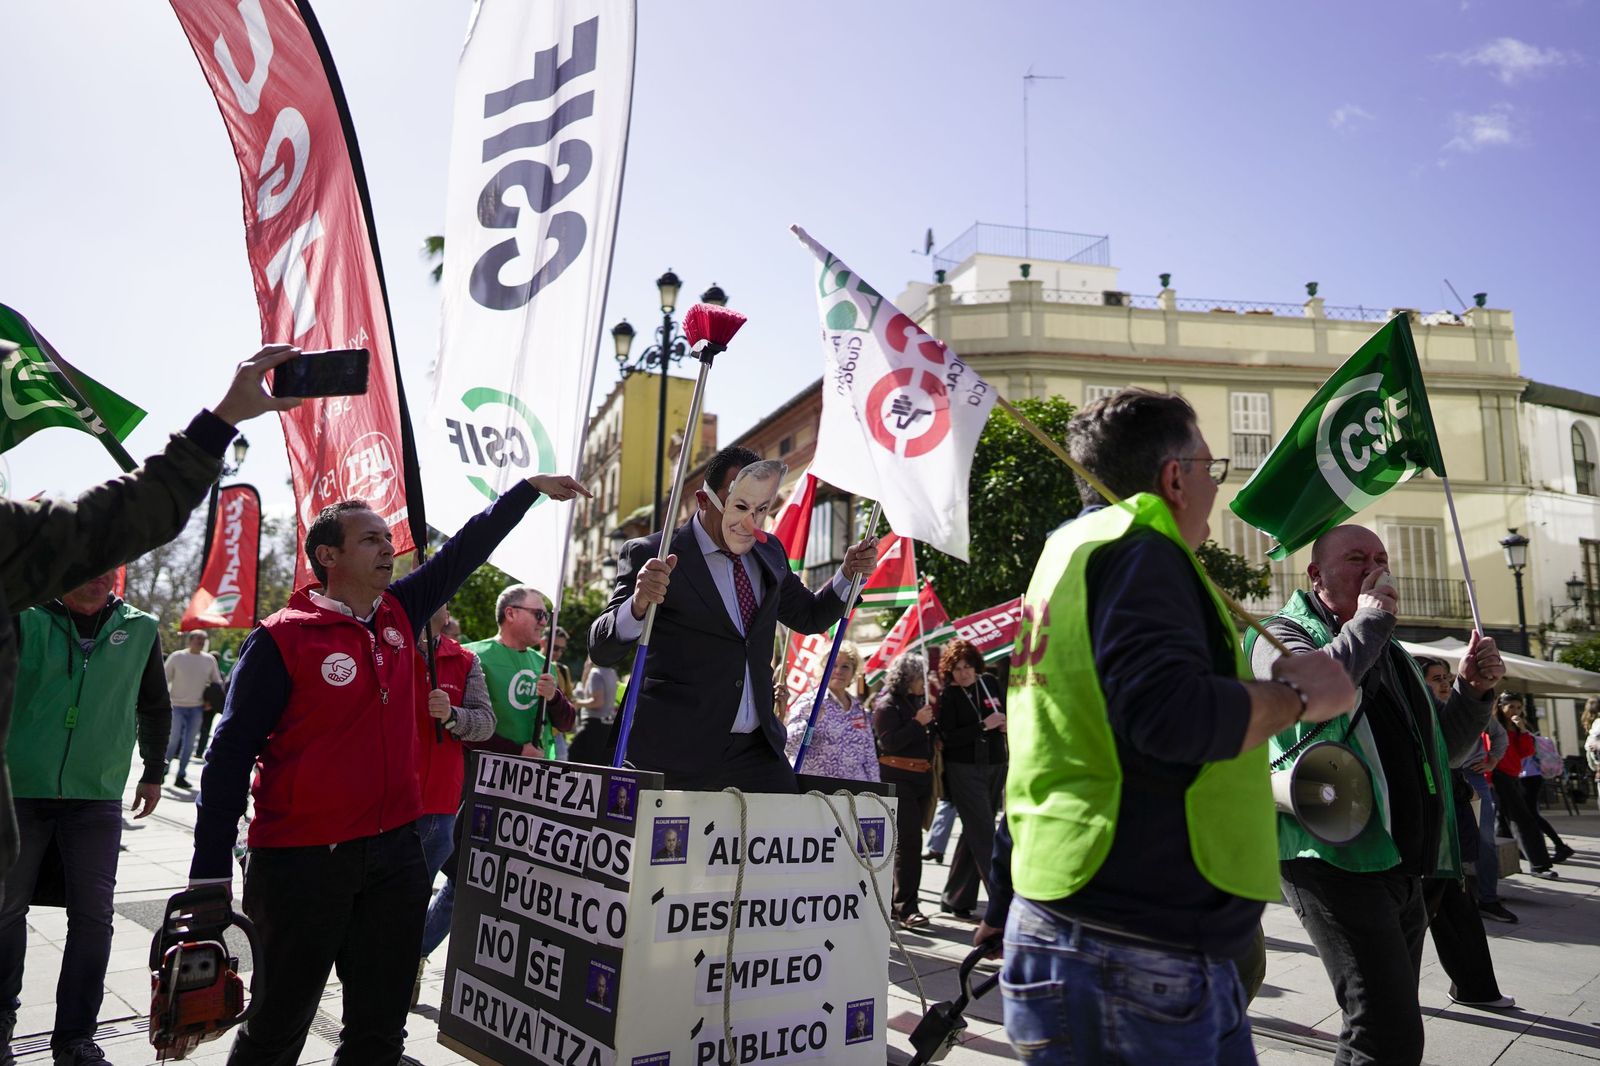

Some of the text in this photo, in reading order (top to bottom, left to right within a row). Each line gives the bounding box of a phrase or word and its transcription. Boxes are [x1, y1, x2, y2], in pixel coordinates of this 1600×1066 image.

[376, 653, 384, 666] UGT
[478, 757, 596, 813] LIMPIEZA
[708, 837, 837, 866] ALCALDE
[468, 851, 627, 939] LO PÚBLICO
[667, 894, 860, 934] DESTRUCTOR
[478, 923, 560, 993] NO SE
[707, 954, 823, 993] EMPLEO
[459, 982, 603, 1066] PRIVATIZA
